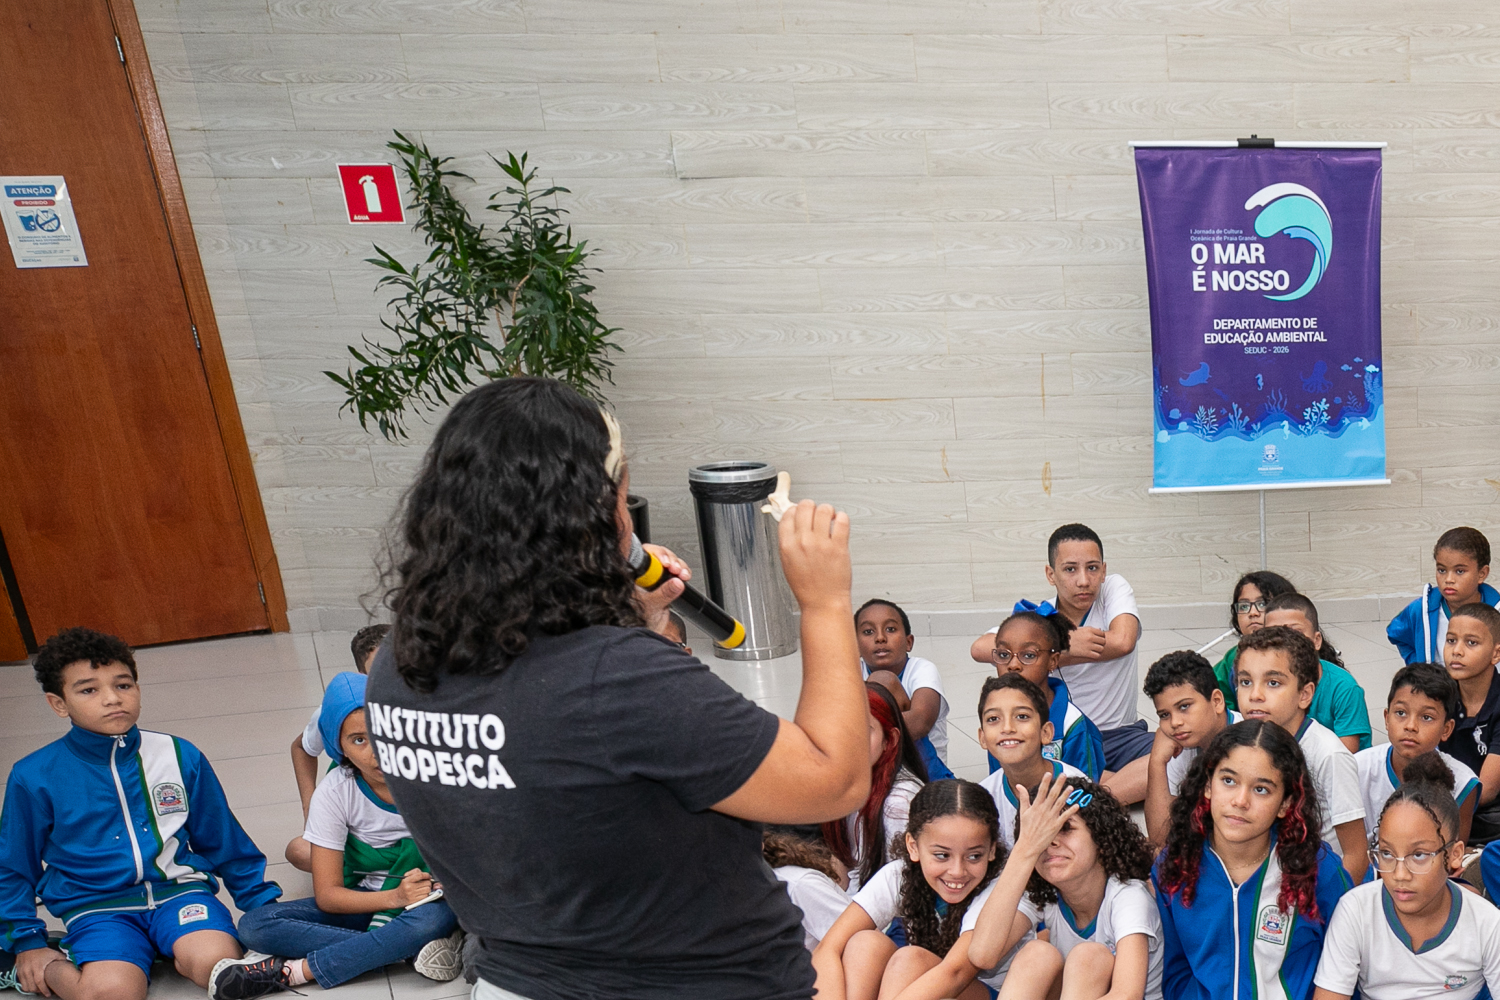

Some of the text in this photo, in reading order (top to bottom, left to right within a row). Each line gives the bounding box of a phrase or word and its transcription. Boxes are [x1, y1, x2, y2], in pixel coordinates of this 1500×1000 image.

[10, 187, 52, 195] ATENÇÃO
[1191, 243, 1266, 264] O MAR
[1192, 265, 1290, 291] É NOSSO
[1213, 317, 1318, 330] DEPARTAMENTO DE
[1203, 330, 1327, 346] EDUCAÇÃO AMBIENTAL
[1244, 346, 1267, 354] SEDUC
[1272, 346, 1289, 354] 2026
[367, 701, 506, 751] INSTITUTO
[375, 739, 517, 790] BIOPESCA
